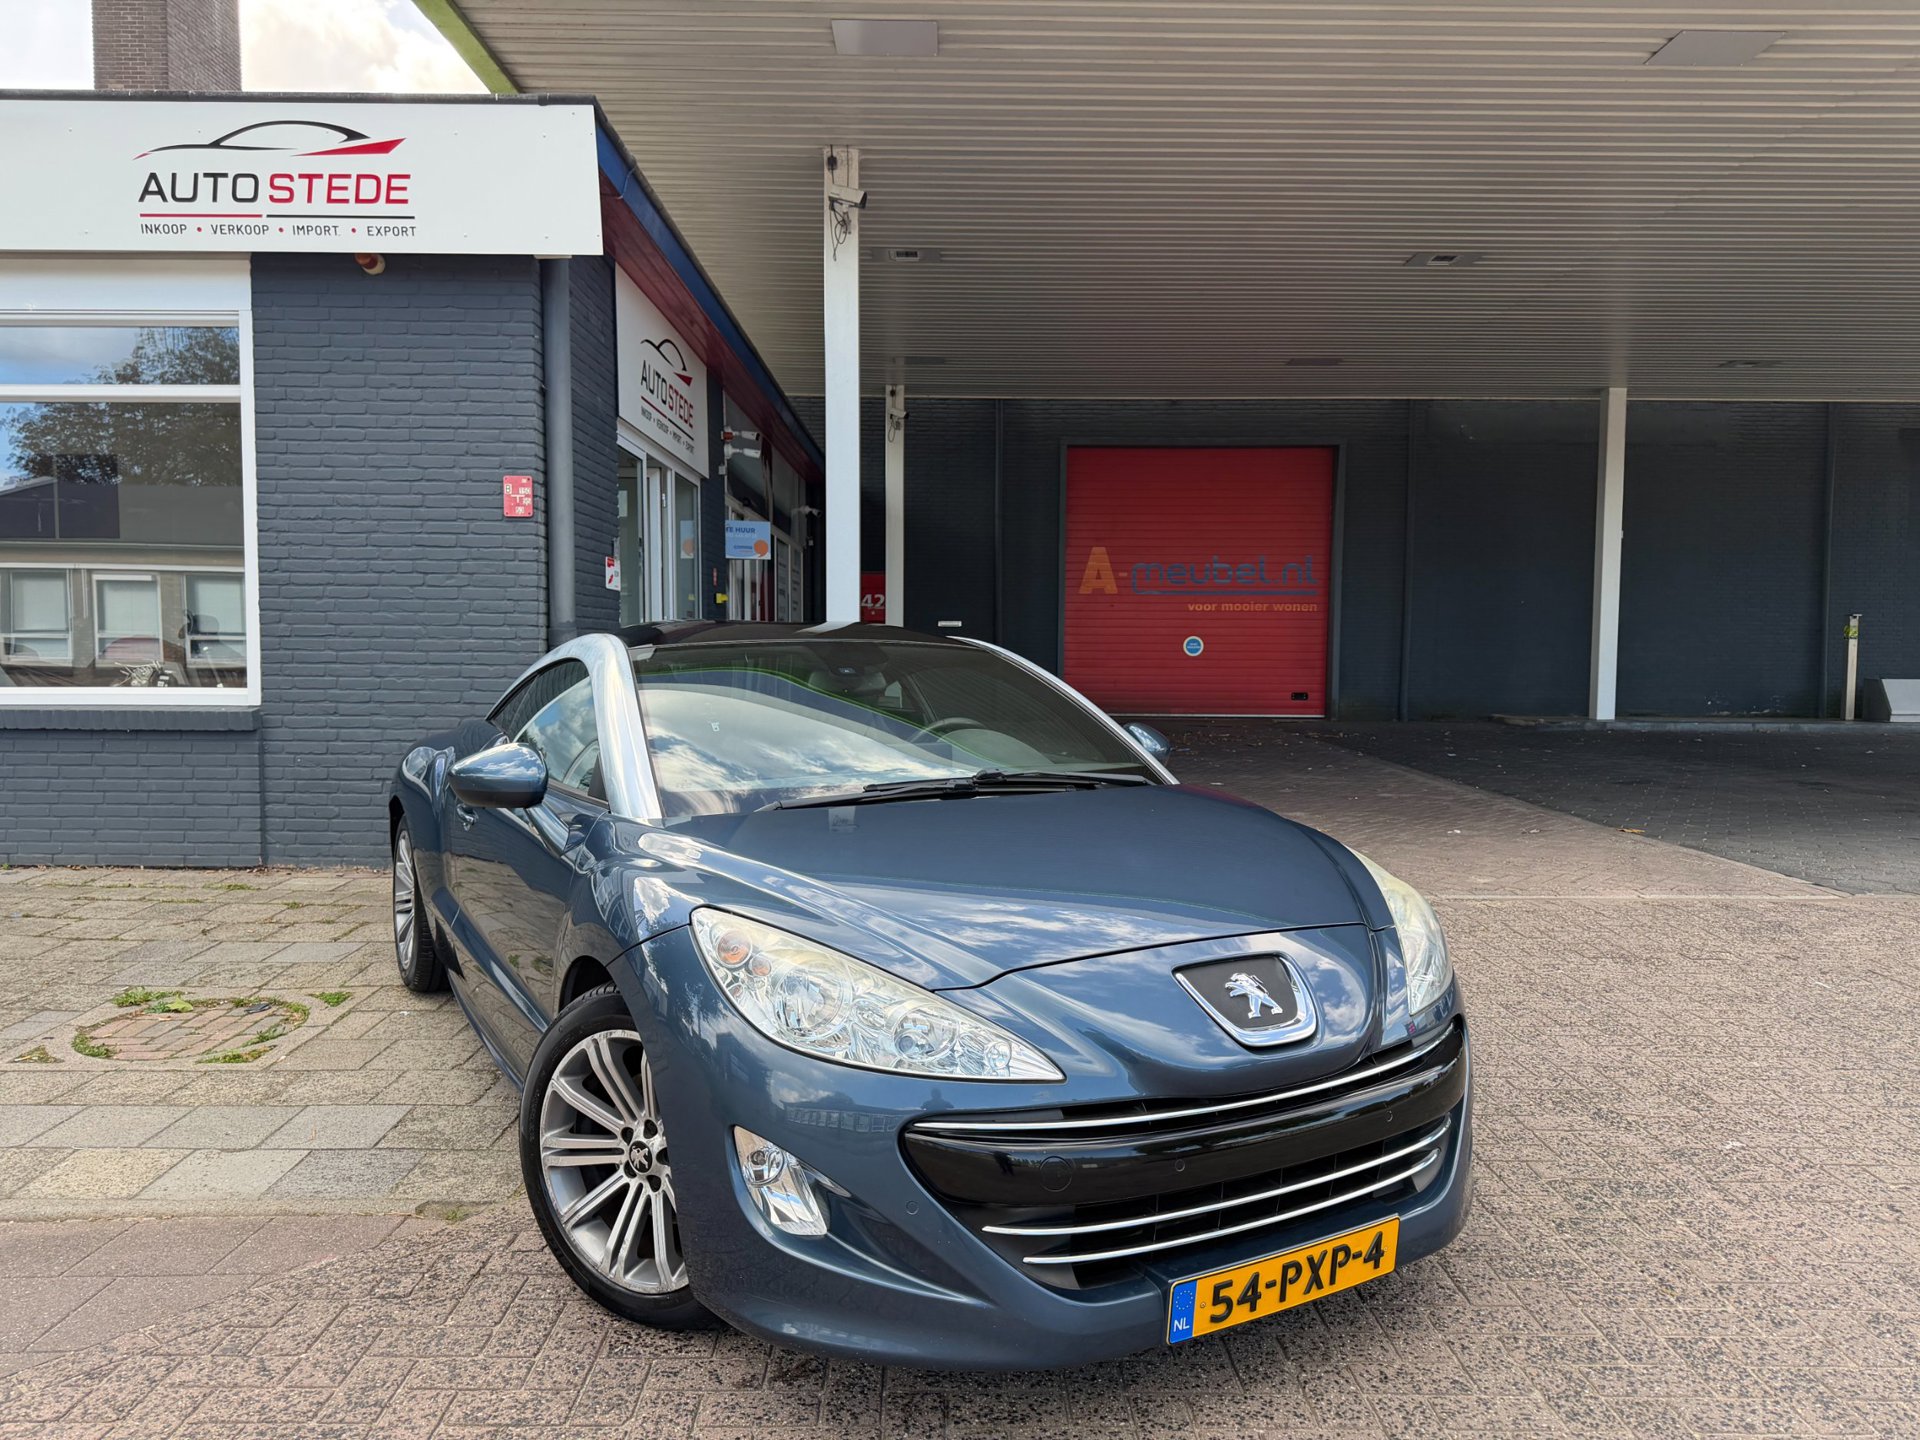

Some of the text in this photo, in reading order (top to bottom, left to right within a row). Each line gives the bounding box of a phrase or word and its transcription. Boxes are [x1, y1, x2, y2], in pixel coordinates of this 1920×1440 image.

[140, 223, 417, 237] INKOOP VERKOOP IMPORT EXPORT
[1188, 601, 1318, 612] voor mooier wonen
[1210, 1231, 1385, 1323] 54-PXP-4
[1173, 1317, 1190, 1332] NL
